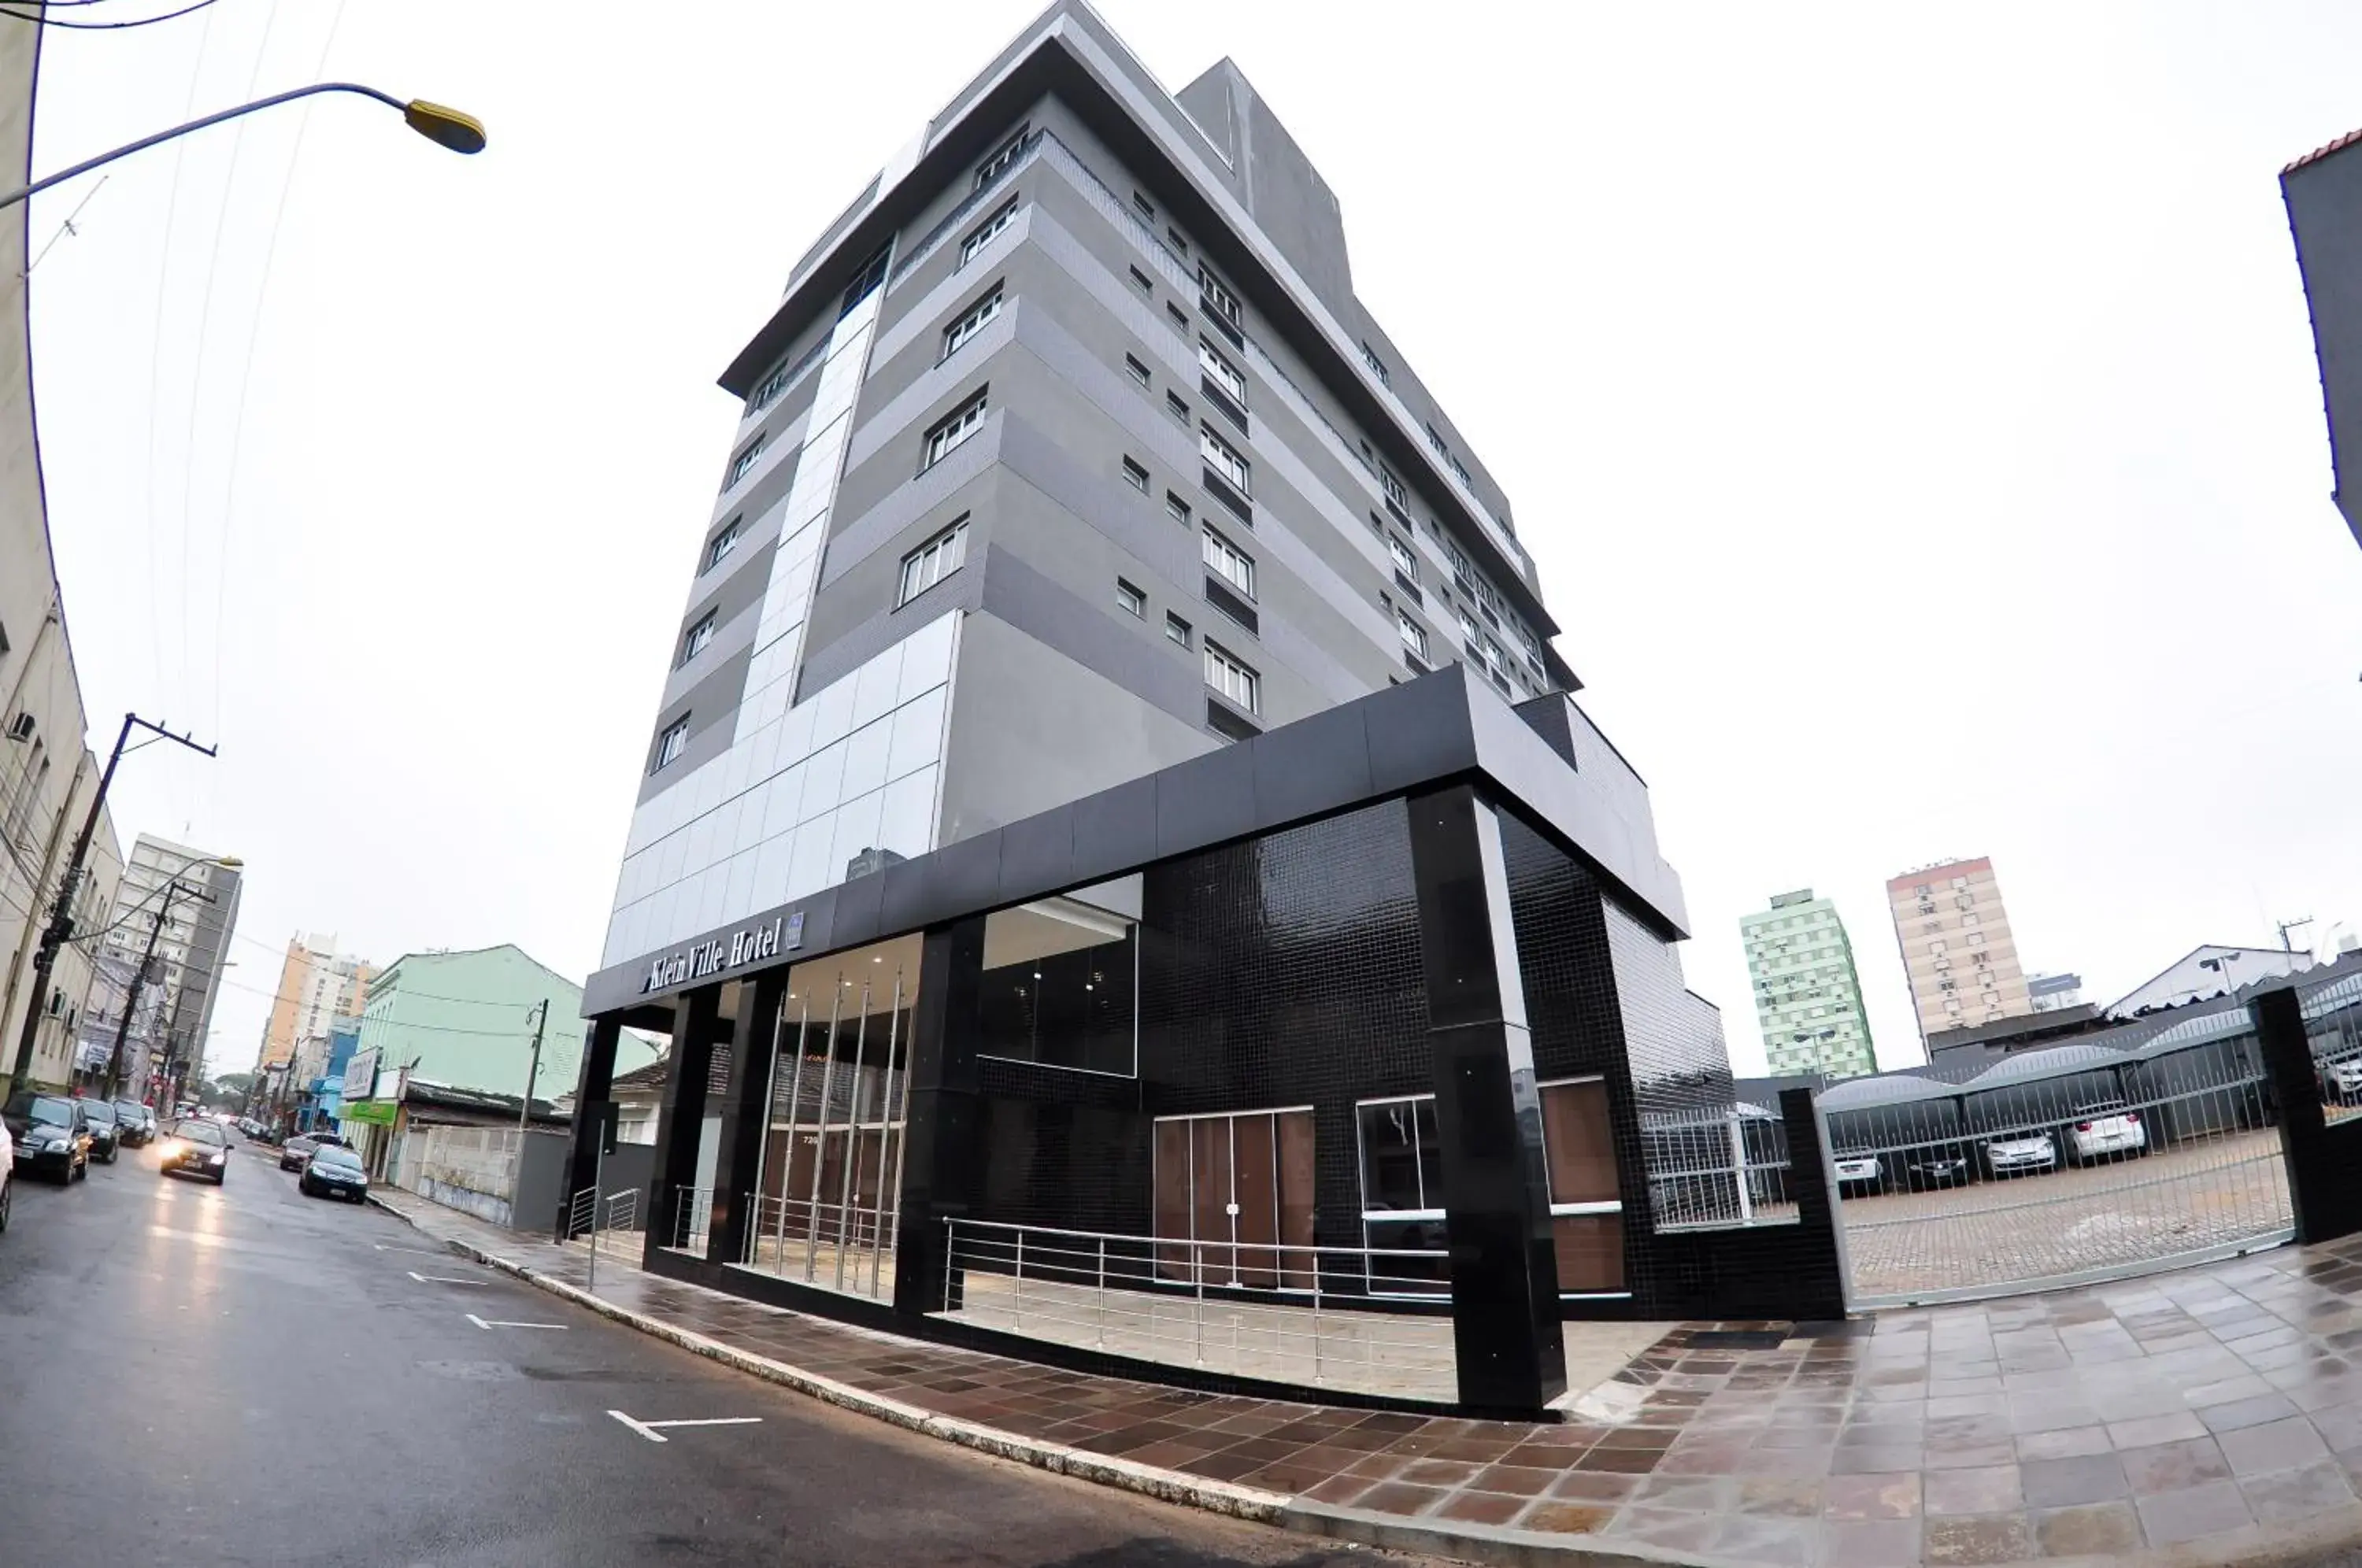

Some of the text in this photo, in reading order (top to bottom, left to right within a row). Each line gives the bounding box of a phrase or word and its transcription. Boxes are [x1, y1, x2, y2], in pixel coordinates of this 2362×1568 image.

[649, 918, 782, 991] Klein Ville Hotel
